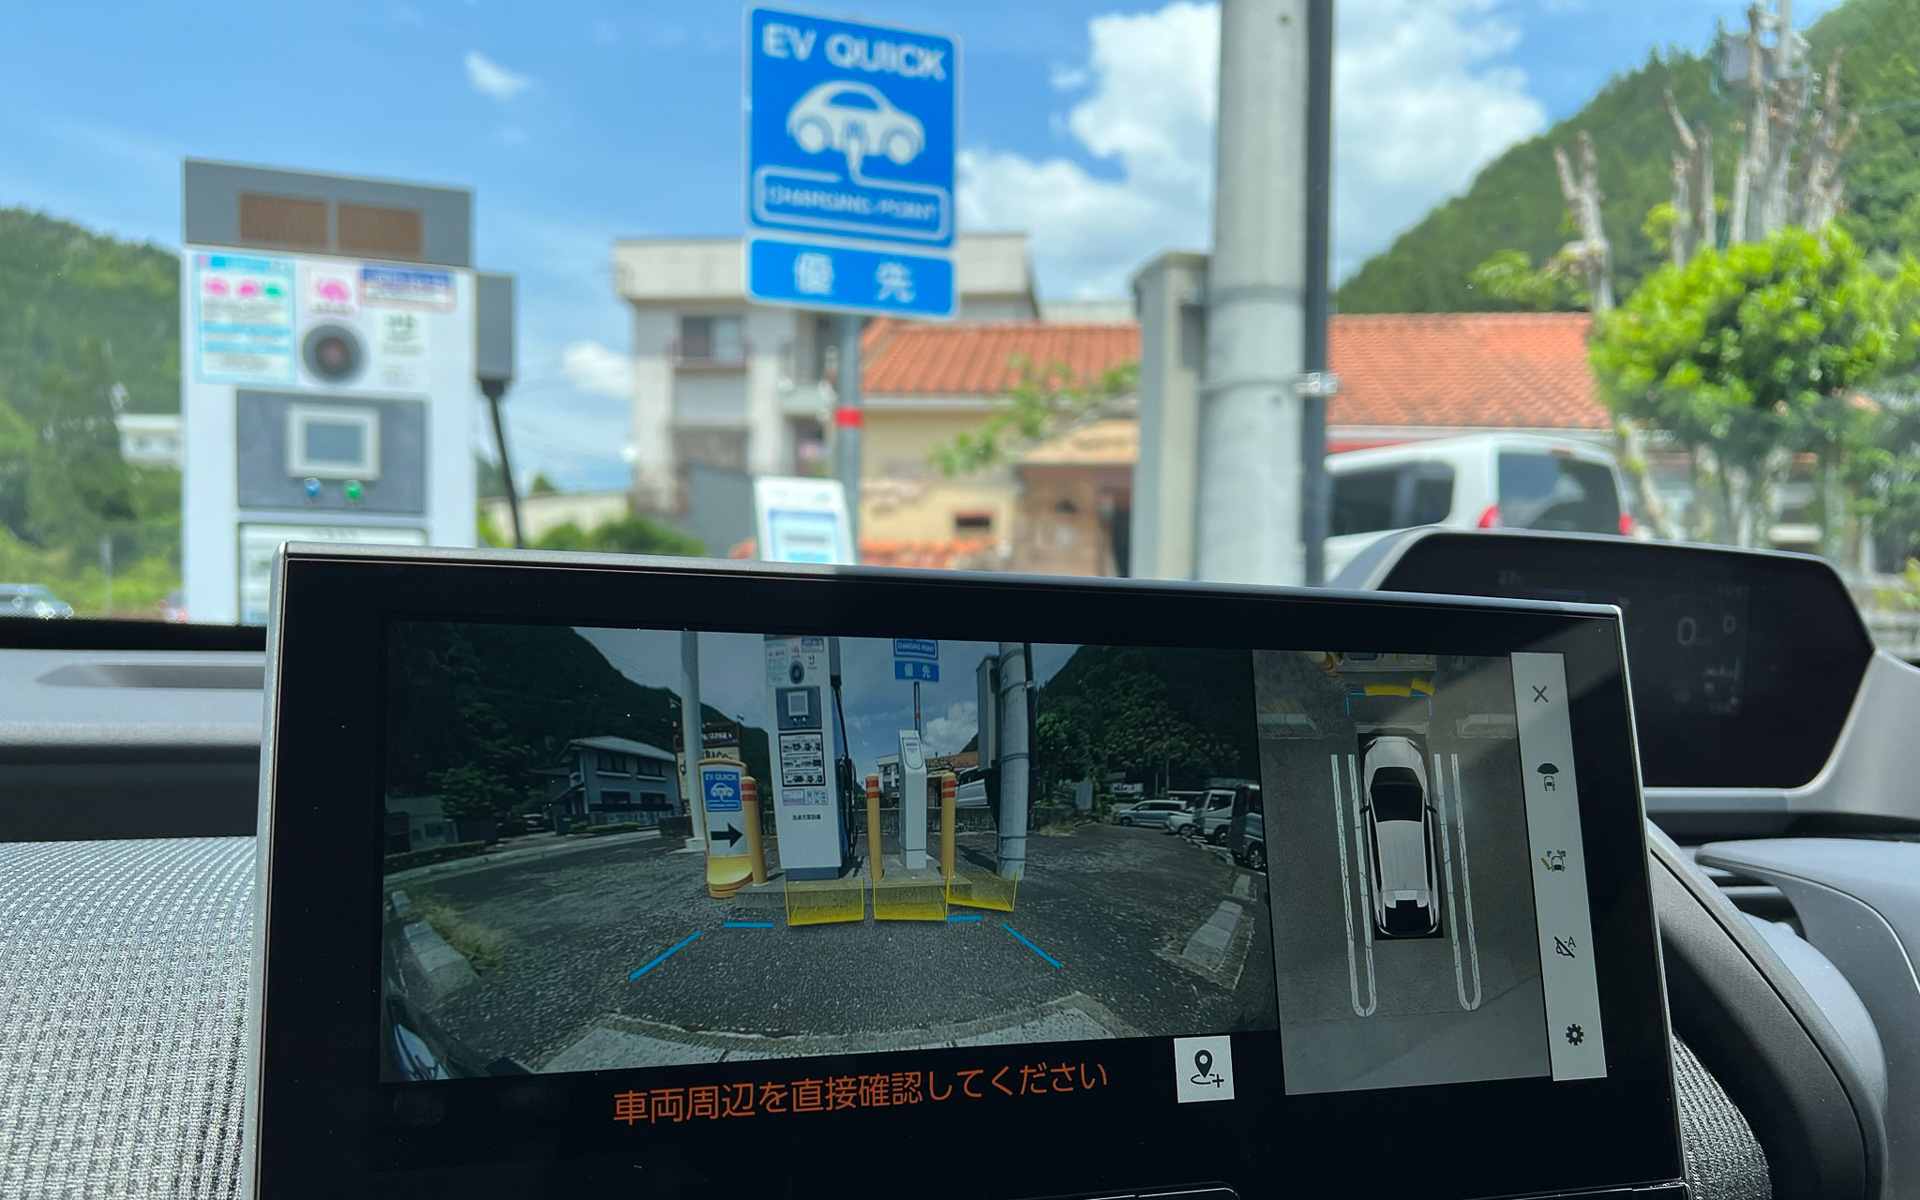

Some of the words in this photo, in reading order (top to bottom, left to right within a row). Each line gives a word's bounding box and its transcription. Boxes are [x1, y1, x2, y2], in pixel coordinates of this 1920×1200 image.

[762, 23, 817, 61] EV
[824, 33, 947, 81] QUICK
[705, 773, 714, 781] EV
[715, 773, 738, 781] QUICK
[611, 1062, 1109, 1126] 車両周辺を直接確認してください
